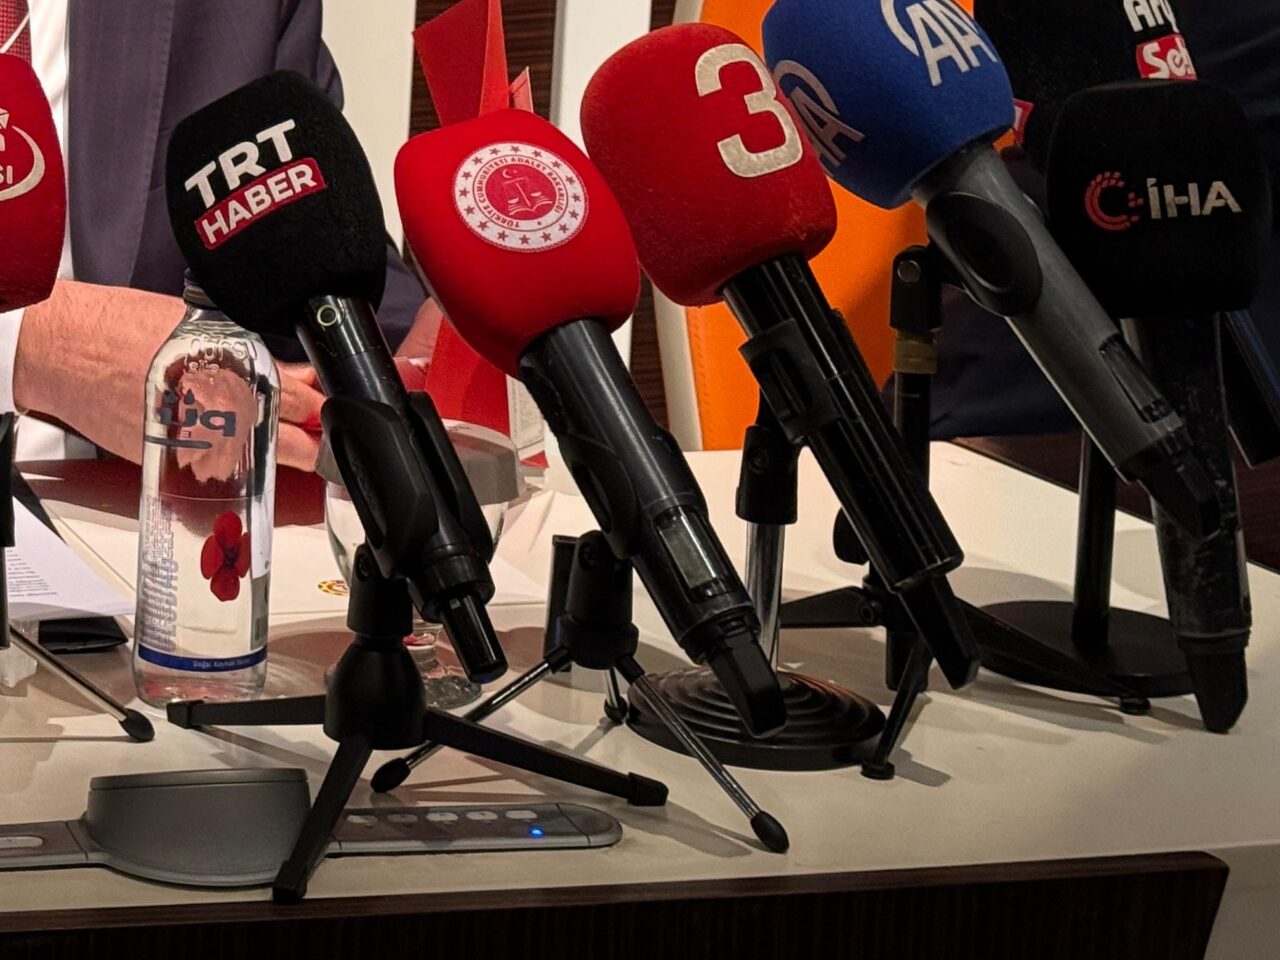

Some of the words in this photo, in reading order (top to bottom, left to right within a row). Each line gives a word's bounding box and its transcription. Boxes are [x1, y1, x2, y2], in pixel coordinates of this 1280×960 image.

[695, 43, 803, 178] 3
[184, 118, 296, 209] TRT
[201, 163, 318, 245] HABER
[510, 156, 547, 172] ADALET
[1146, 177, 1243, 220] İHA
